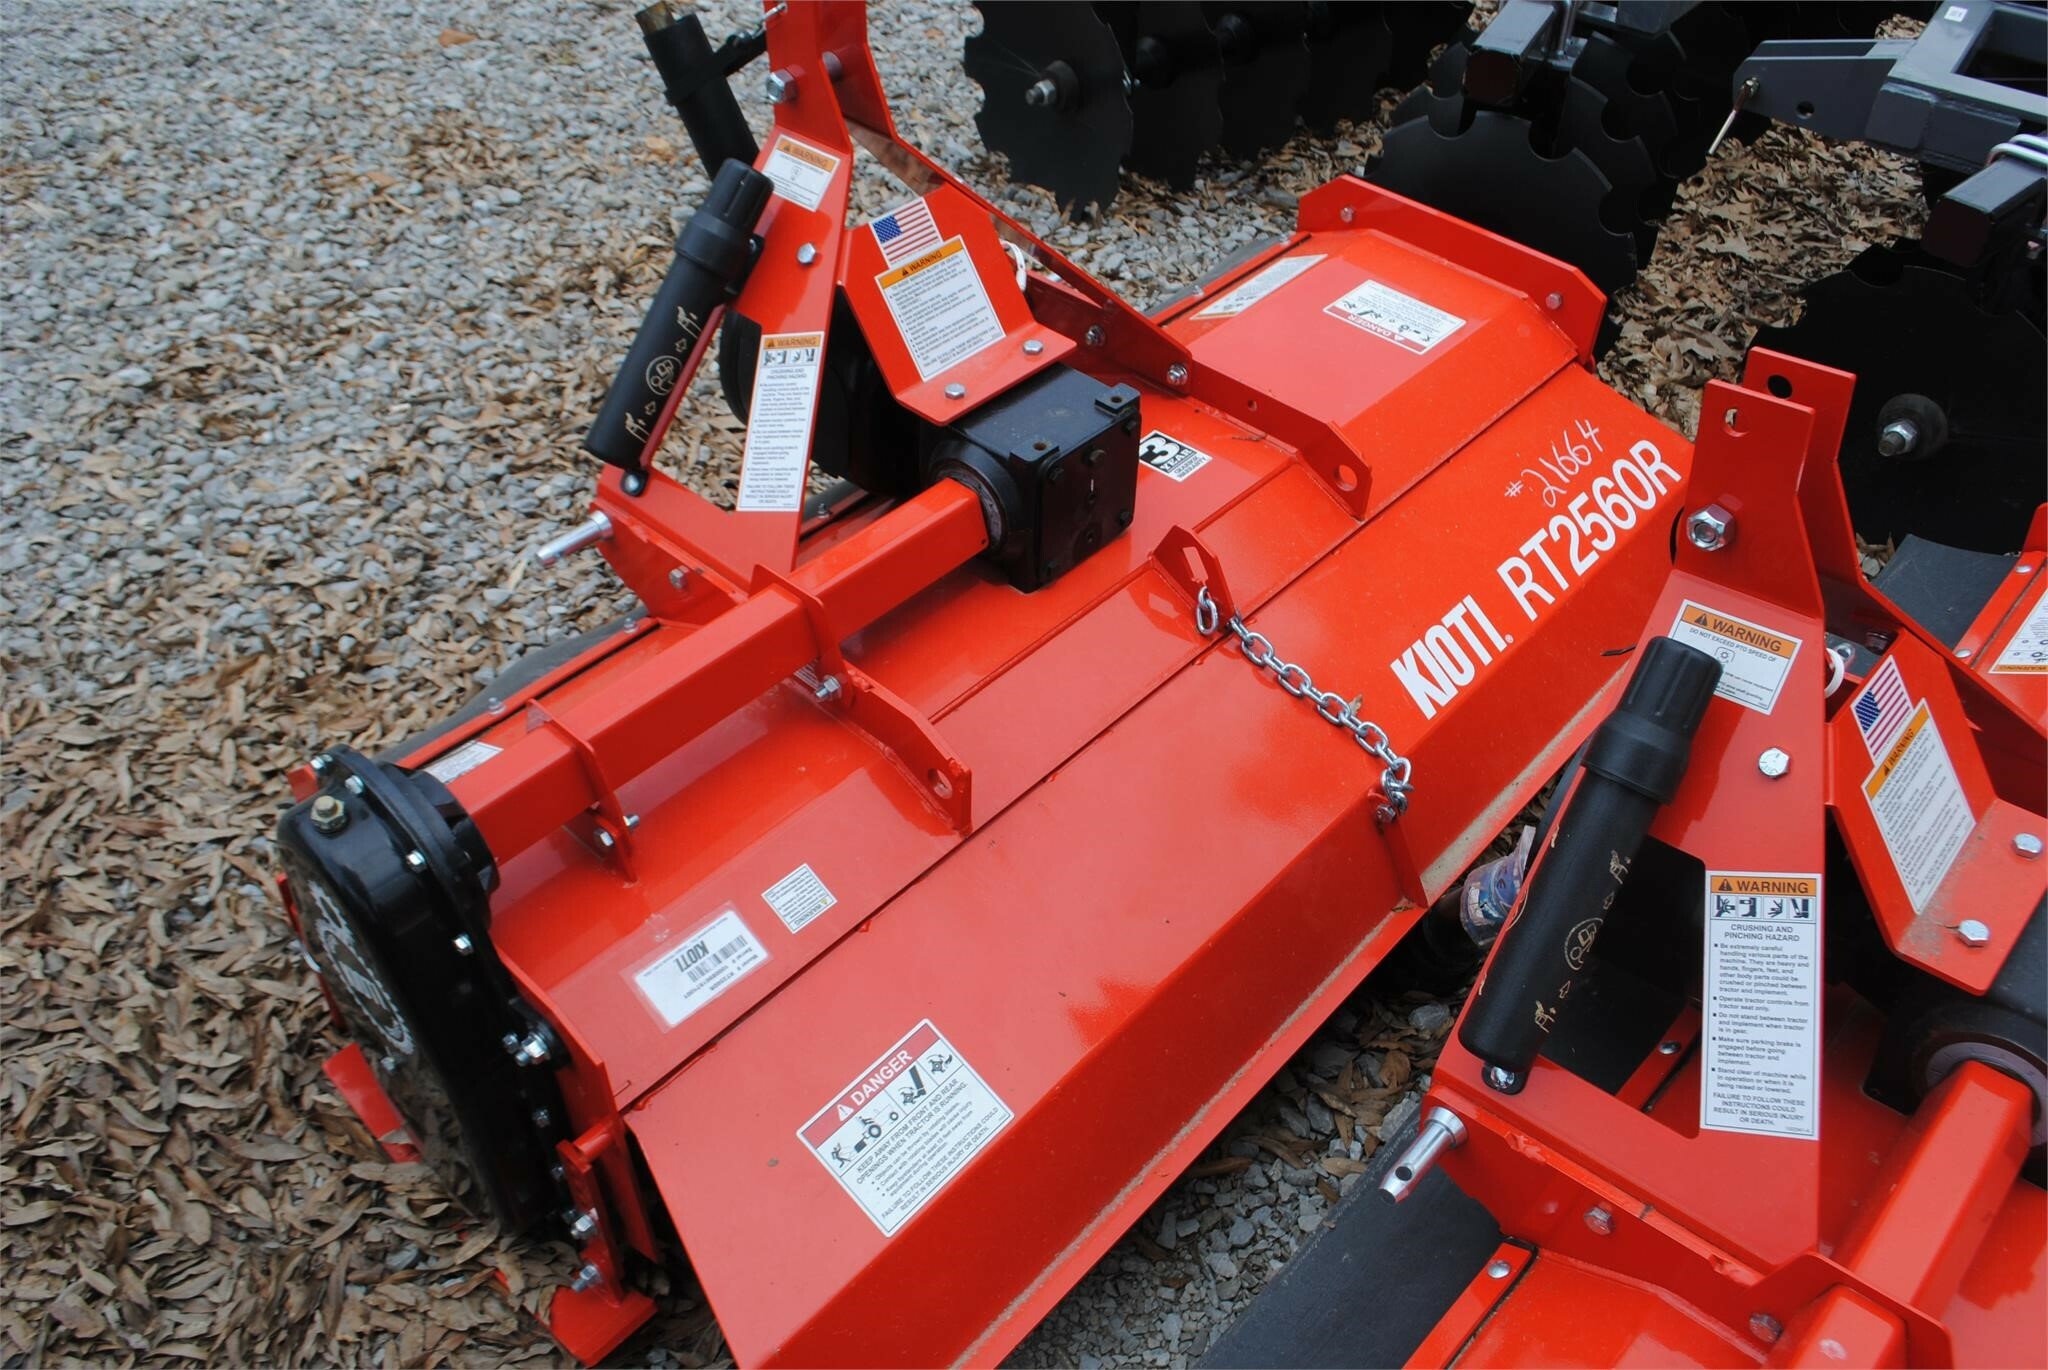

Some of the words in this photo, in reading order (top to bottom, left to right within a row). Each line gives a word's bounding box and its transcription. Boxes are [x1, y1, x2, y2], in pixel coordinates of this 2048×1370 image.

[909, 250, 942, 271] WARNING
[1346, 314, 1392, 336] DANGER
[777, 337, 815, 346] WARNING
[1139, 437, 1180, 465] 3
[1160, 449, 1192, 471] YEAR
[1496, 440, 1681, 621] RT2560R
[1698, 631, 1711, 639] NOT
[1711, 635, 1734, 647] EXCEED
[1735, 643, 1747, 651] PTO
[1747, 648, 1767, 658] SPEED
[1711, 619, 1782, 651] WARNING
[1887, 726, 1914, 768] WARNING
[1737, 880, 1808, 893] WARNING
[1724, 931, 1762, 939] PINCHING
[1765, 933, 1799, 941] HAZARD
[1731, 923, 1773, 931] CRUSHING
[673, 941, 710, 971] KIOTI
[851, 1049, 912, 1105] DANGER
[1725, 1075, 1753, 1083] operation
[1713, 1092, 1740, 1100] FAILURE
[1722, 1100, 1769, 1110] INSTRUCTIONS
[1713, 1106, 1738, 1114] RESULT
[1749, 1110, 1777, 1118] SERIOUS
[856, 1155, 874, 1173] KEEP
[873, 1140, 891, 1157] AWAY
[890, 1124, 909, 1141] FROM
[908, 1105, 929, 1125] FRONT
[928, 1093, 942, 1107] AND
[941, 1079, 958, 1095] REAR
[856, 1154, 888, 1185] OPENINGS
[887, 1137, 906, 1156] WHEN
[905, 1112, 934, 1139] TRACTOR
[933, 1106, 940, 1114] IS
[939, 1081, 968, 1108] RUNNING.
[881, 1197, 903, 1218] FAILURE
[902, 1189, 911, 1198] TO
[910, 1169, 932, 1191] FOLLOW
[931, 1154, 948, 1171] THESE
[947, 1122, 982, 1156] INSTRUCTIONS
[980, 1106, 998, 1124] COULD
[900, 1191, 920, 1211] RESULT
[919, 1185, 926, 1193] IN
[925, 1165, 948, 1187] SERIOUS
[946, 1148, 965, 1167] INJURY
[964, 1141, 973, 1150] OR
